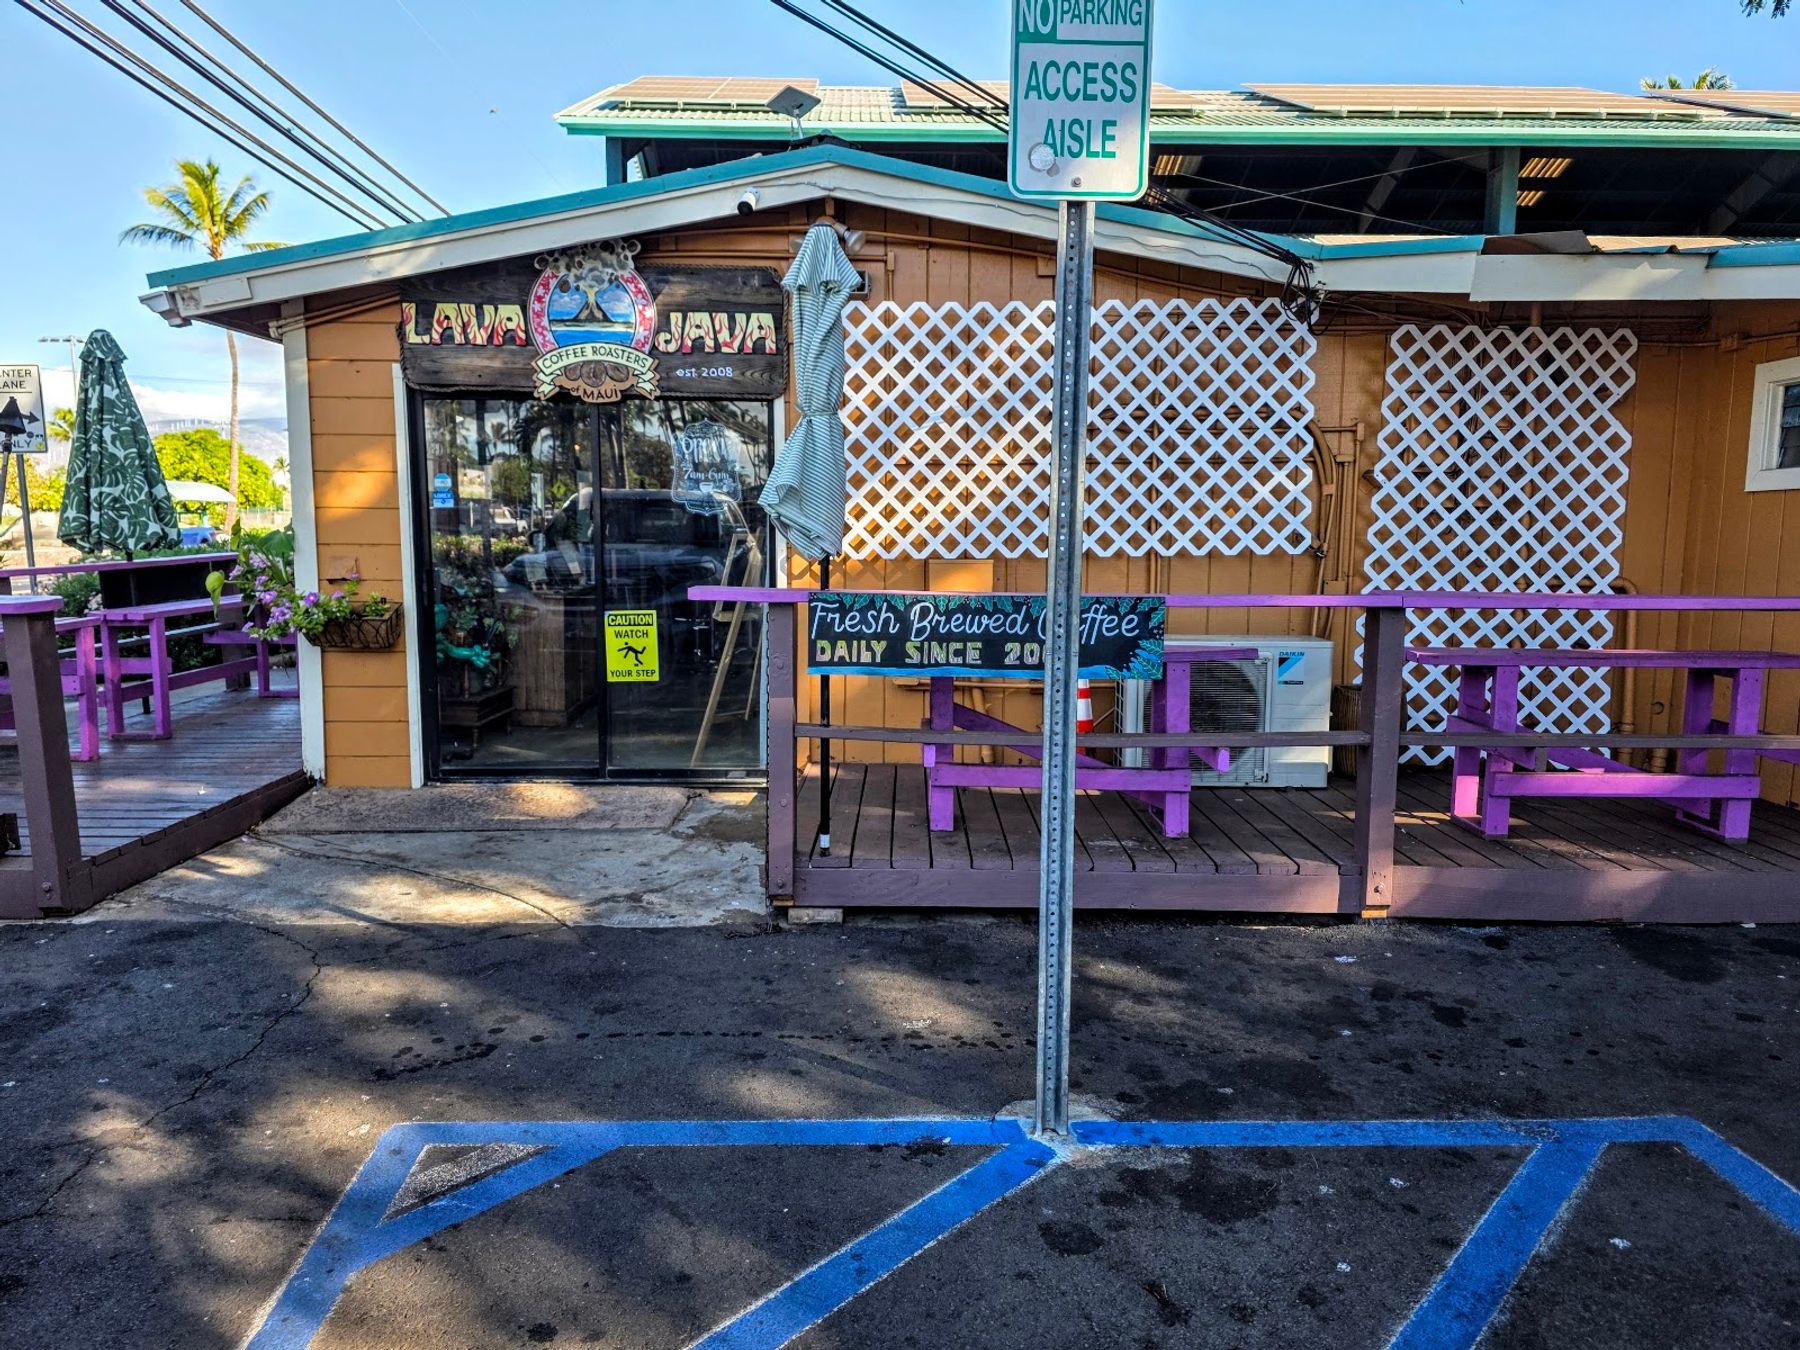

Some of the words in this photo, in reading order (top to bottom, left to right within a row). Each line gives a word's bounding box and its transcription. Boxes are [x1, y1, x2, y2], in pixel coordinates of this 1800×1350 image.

[1018, 0, 1054, 34] NO
[1060, 0, 1142, 26] PARKING
[1023, 60, 1138, 104] ACCESS
[1043, 118, 1118, 159] AISLE
[401, 302, 527, 346] LAVA
[655, 312, 777, 354] JAVA
[542, 346, 588, 369] COFFEE
[591, 346, 649, 368] ROASTERS
[0, 369, 32, 378] NTER
[701, 366, 734, 378] 2008
[571, 385, 581, 394] of
[3, 439, 32, 448] NLY
[608, 614, 653, 626] CAUTION
[809, 602, 900, 640] Fresh
[910, 602, 1030, 641] Brewed
[1037, 604, 1140, 645] ffee
[614, 629, 649, 639] WATCH
[815, 640, 888, 663] DAILY
[904, 641, 982, 665] SINCE
[1004, 642, 1047, 665] 20
[610, 669, 633, 678] YOUR
[635, 669, 656, 677] STEP
